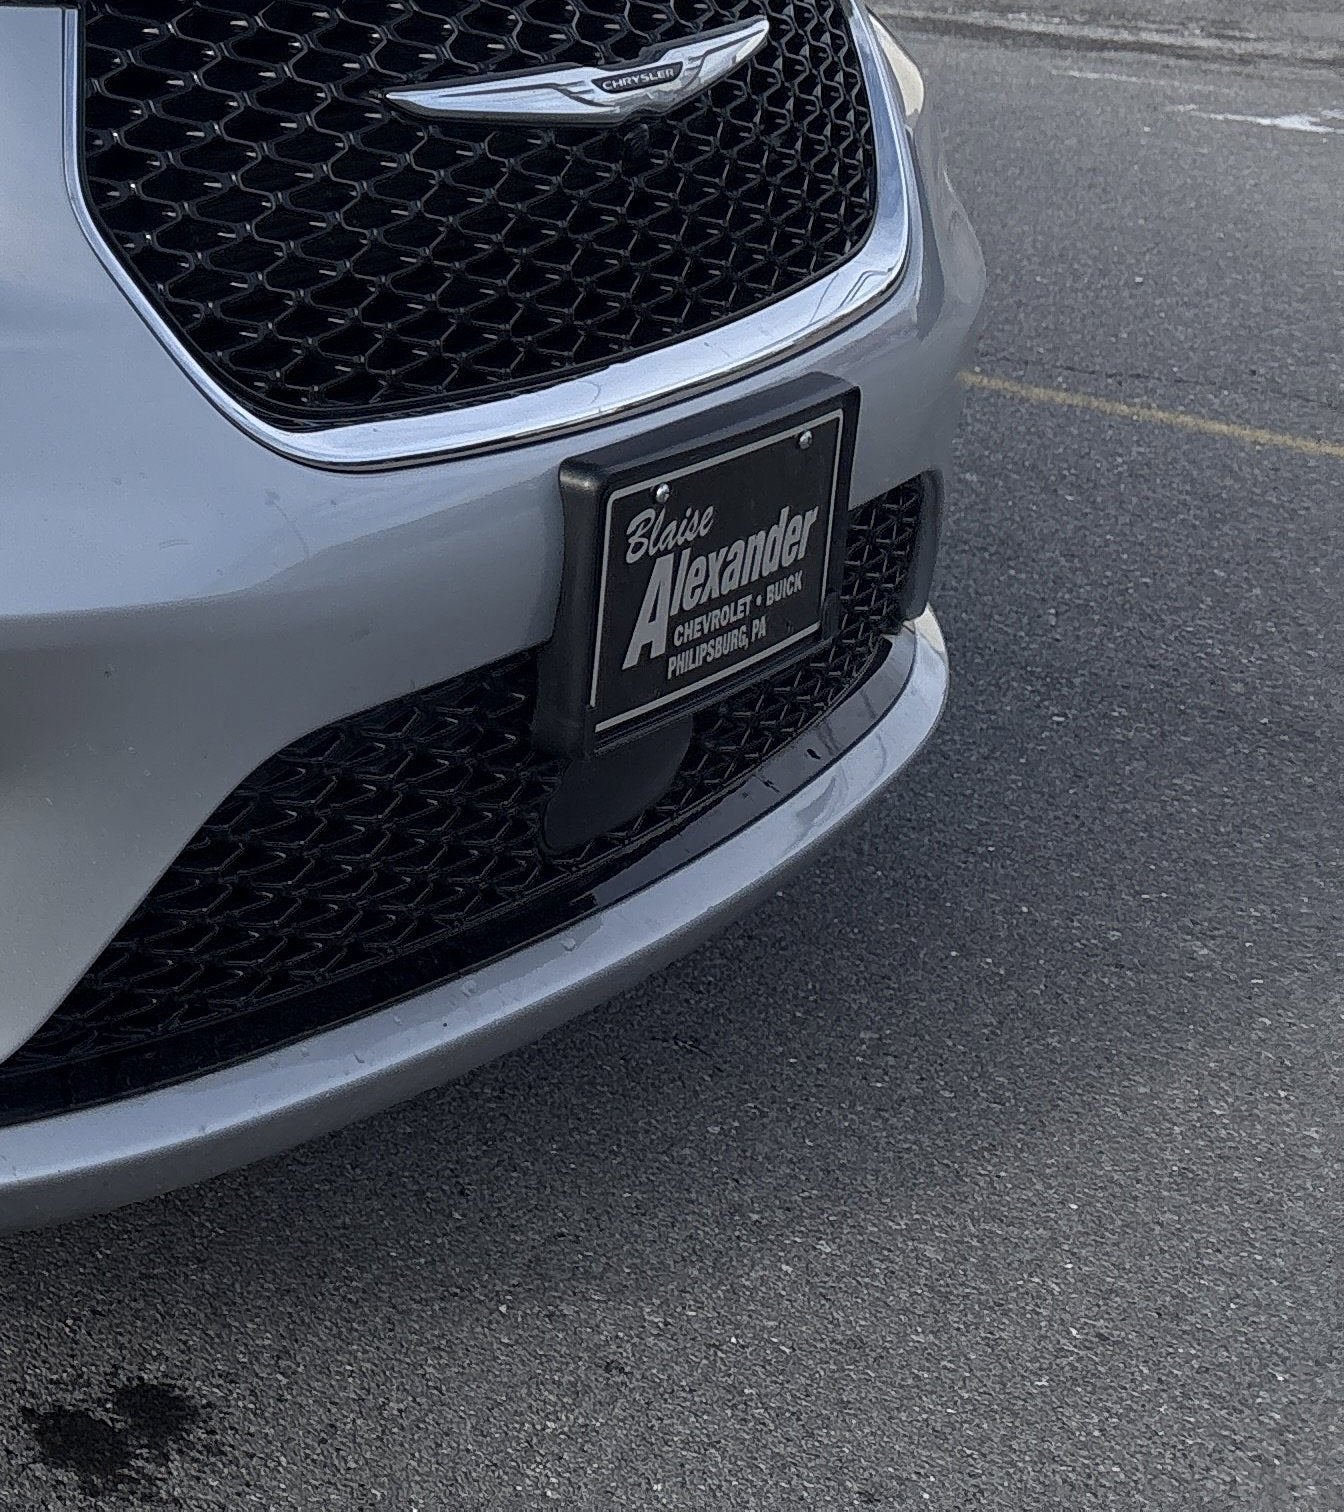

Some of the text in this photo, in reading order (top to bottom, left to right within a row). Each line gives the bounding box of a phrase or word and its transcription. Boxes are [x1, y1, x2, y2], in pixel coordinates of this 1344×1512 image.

[601, 68, 675, 90] CHRYSLER
[624, 504, 716, 565] Blaise
[621, 504, 819, 672] Alexander
[673, 569, 804, 647] CHEVROLET BUICK
[667, 614, 768, 680] PHILIPSBURG, PA
